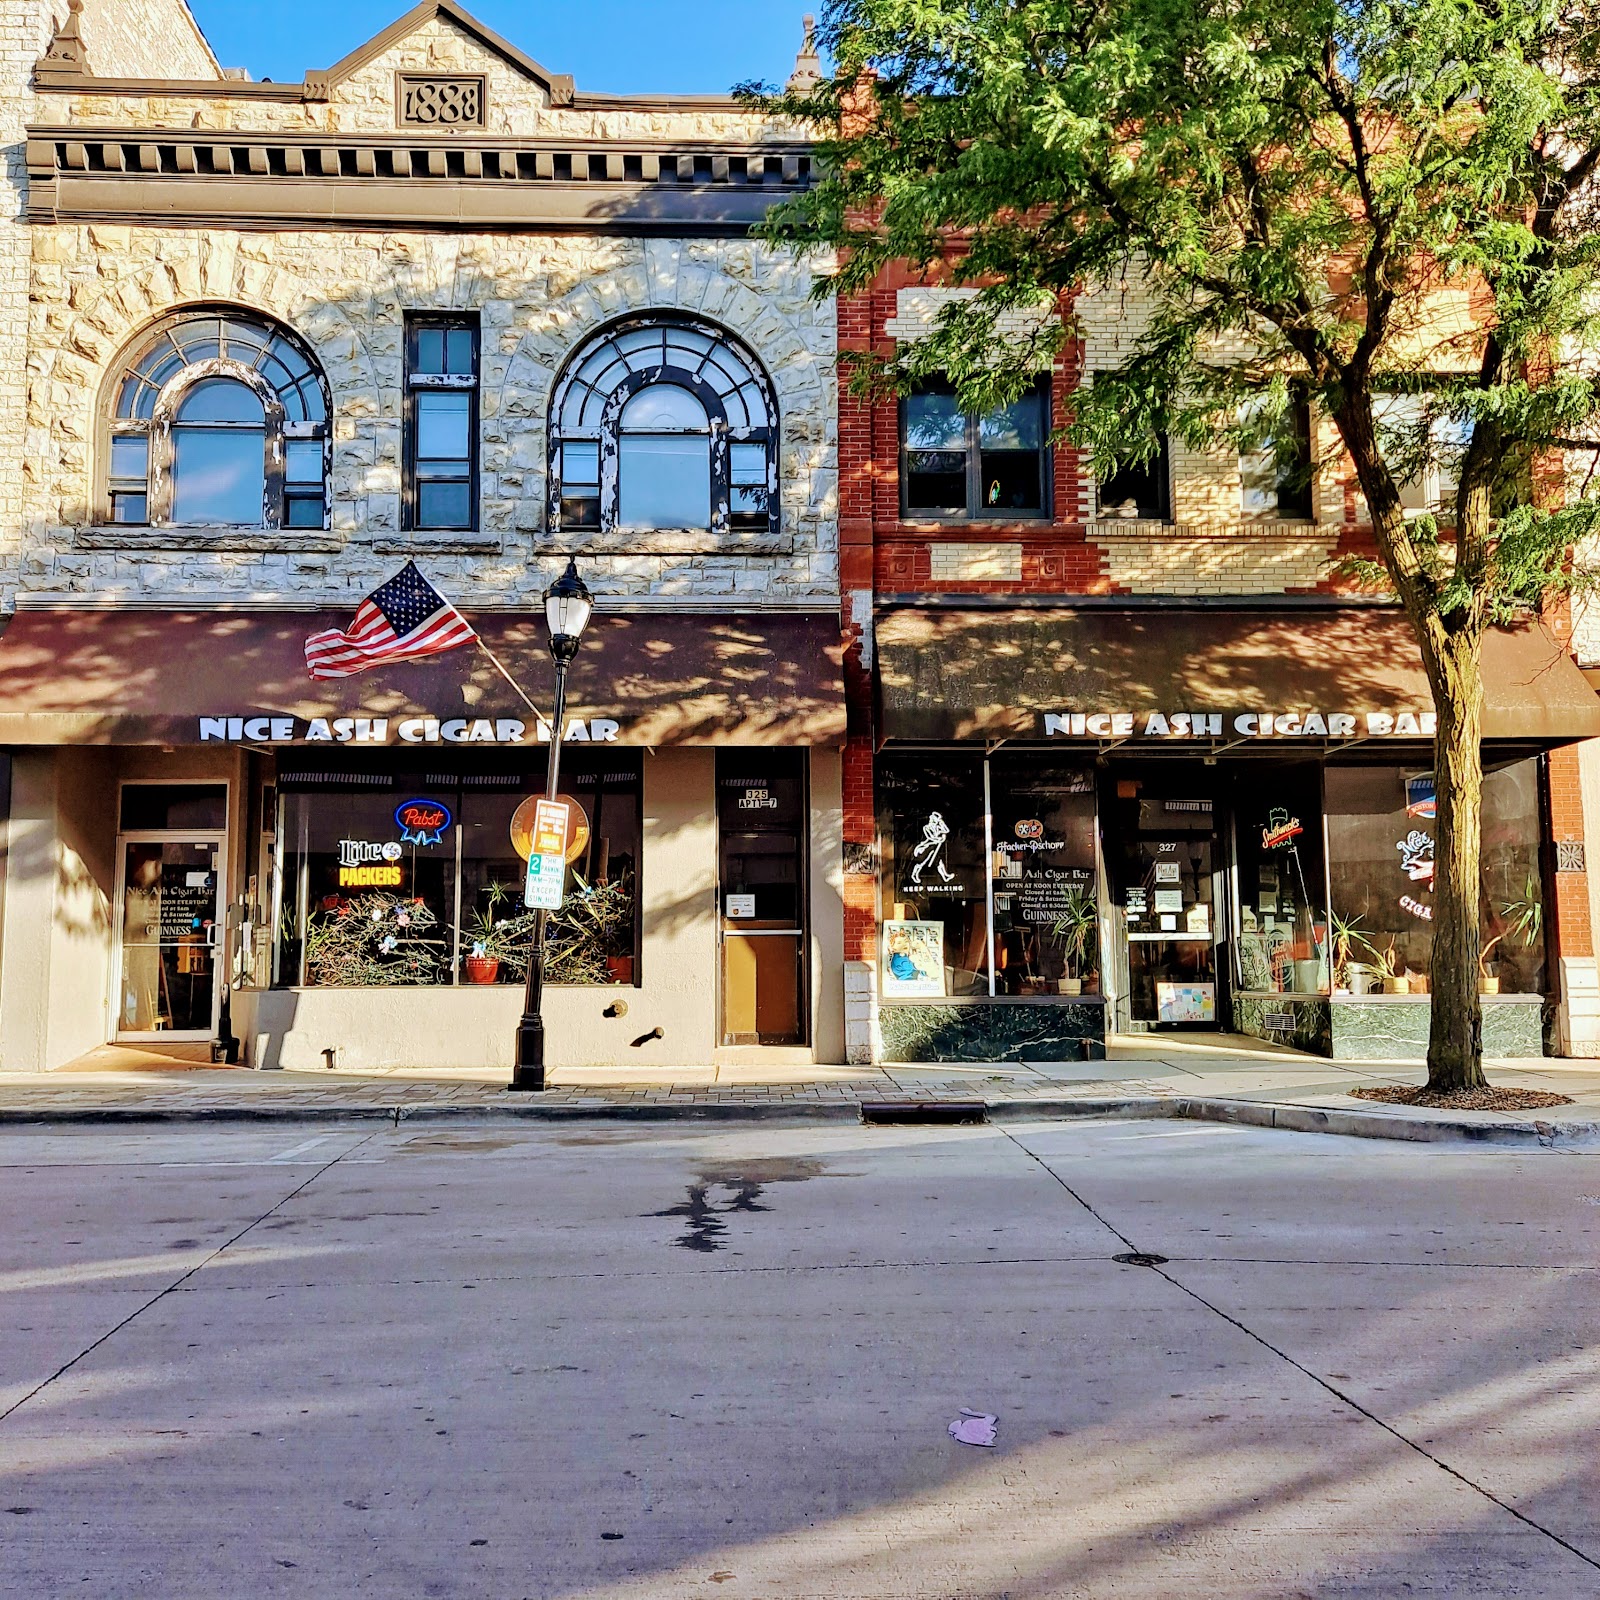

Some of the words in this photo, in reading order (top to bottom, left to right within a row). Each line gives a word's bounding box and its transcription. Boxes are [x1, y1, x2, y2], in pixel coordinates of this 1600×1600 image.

[405, 84, 478, 123] 1888
[200, 717, 295, 741] NICE
[304, 718, 388, 741] ASH
[398, 719, 525, 742] CIGAR
[536, 719, 620, 742] BAR
[1044, 713, 1133, 735] NICE
[1144, 713, 1222, 735] ASH
[1234, 713, 1356, 735] CIGAR
[747, 790, 767, 799] 325
[1411, 802, 1434, 813] BOSTON
[404, 808, 444, 826] Pabst
[338, 840, 382, 867] Lite
[1158, 843, 1177, 851] 327
[531, 856, 540, 871] 2
[339, 866, 401, 887] PACKERS
[1023, 869, 1042, 880] Ash
[1044, 869, 1069, 881] Cigar
[1072, 869, 1090, 879] Bar
[531, 886, 557, 895] EXCEPT
[1023, 909, 1069, 920] GUINNESS
[1399, 895, 1433, 920] CIGA
[146, 924, 192, 935] GUINNESS
